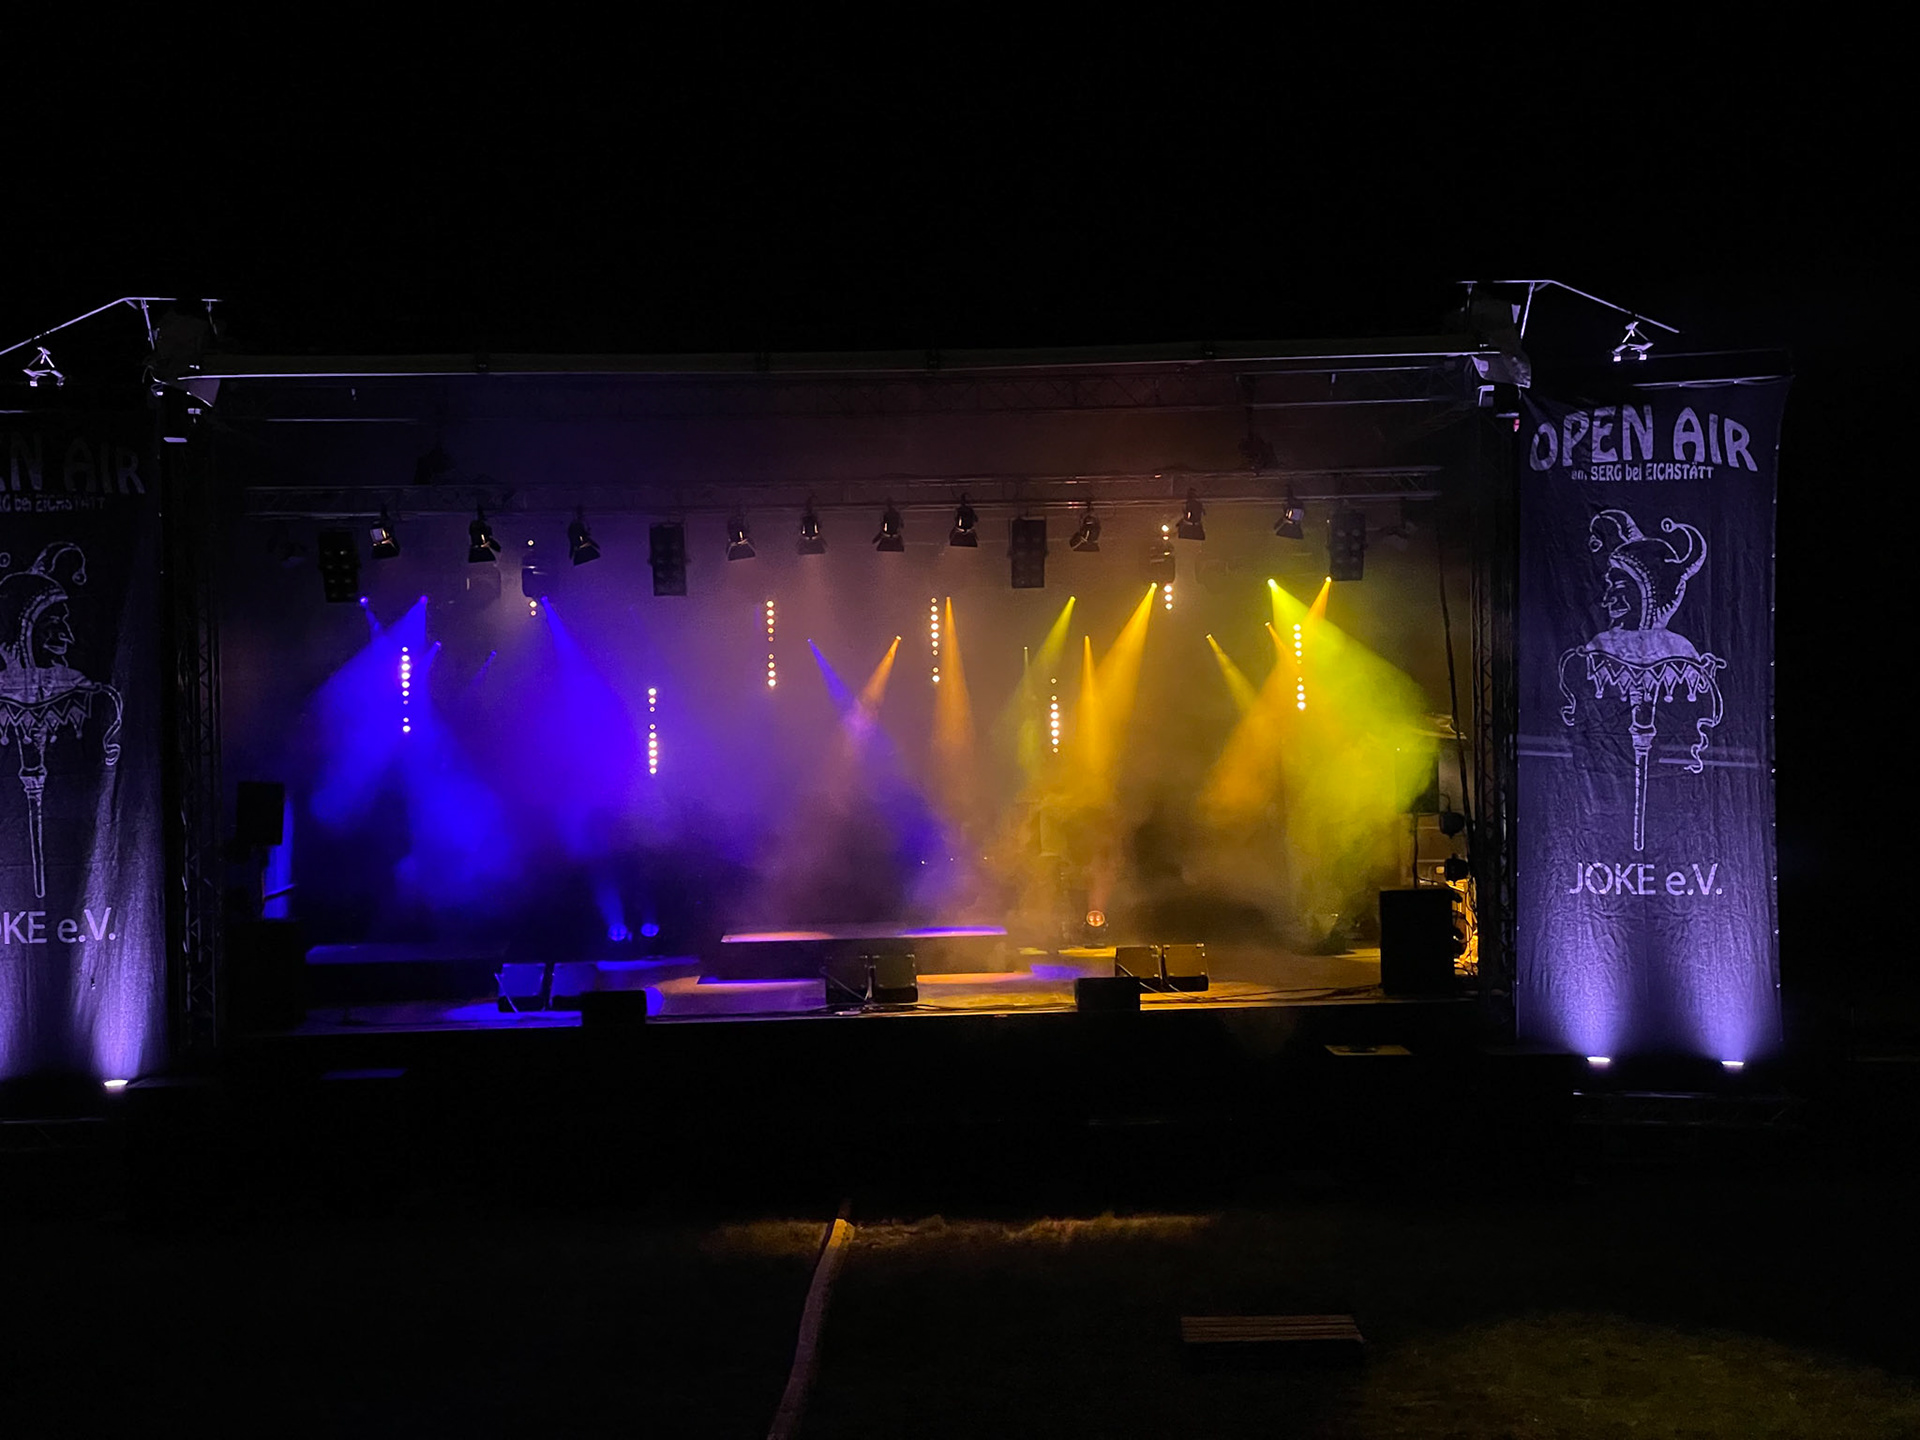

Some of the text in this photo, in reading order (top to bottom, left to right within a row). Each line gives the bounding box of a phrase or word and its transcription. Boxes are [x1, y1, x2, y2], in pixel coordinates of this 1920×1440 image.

[1529, 404, 1758, 471] OPEN AIR
[64, 436, 146, 495] AIR
[1645, 461, 1714, 481] EICHSTÄTT
[1568, 862, 1723, 896] JOKE e.V.
[57, 906, 116, 944] e.V.
